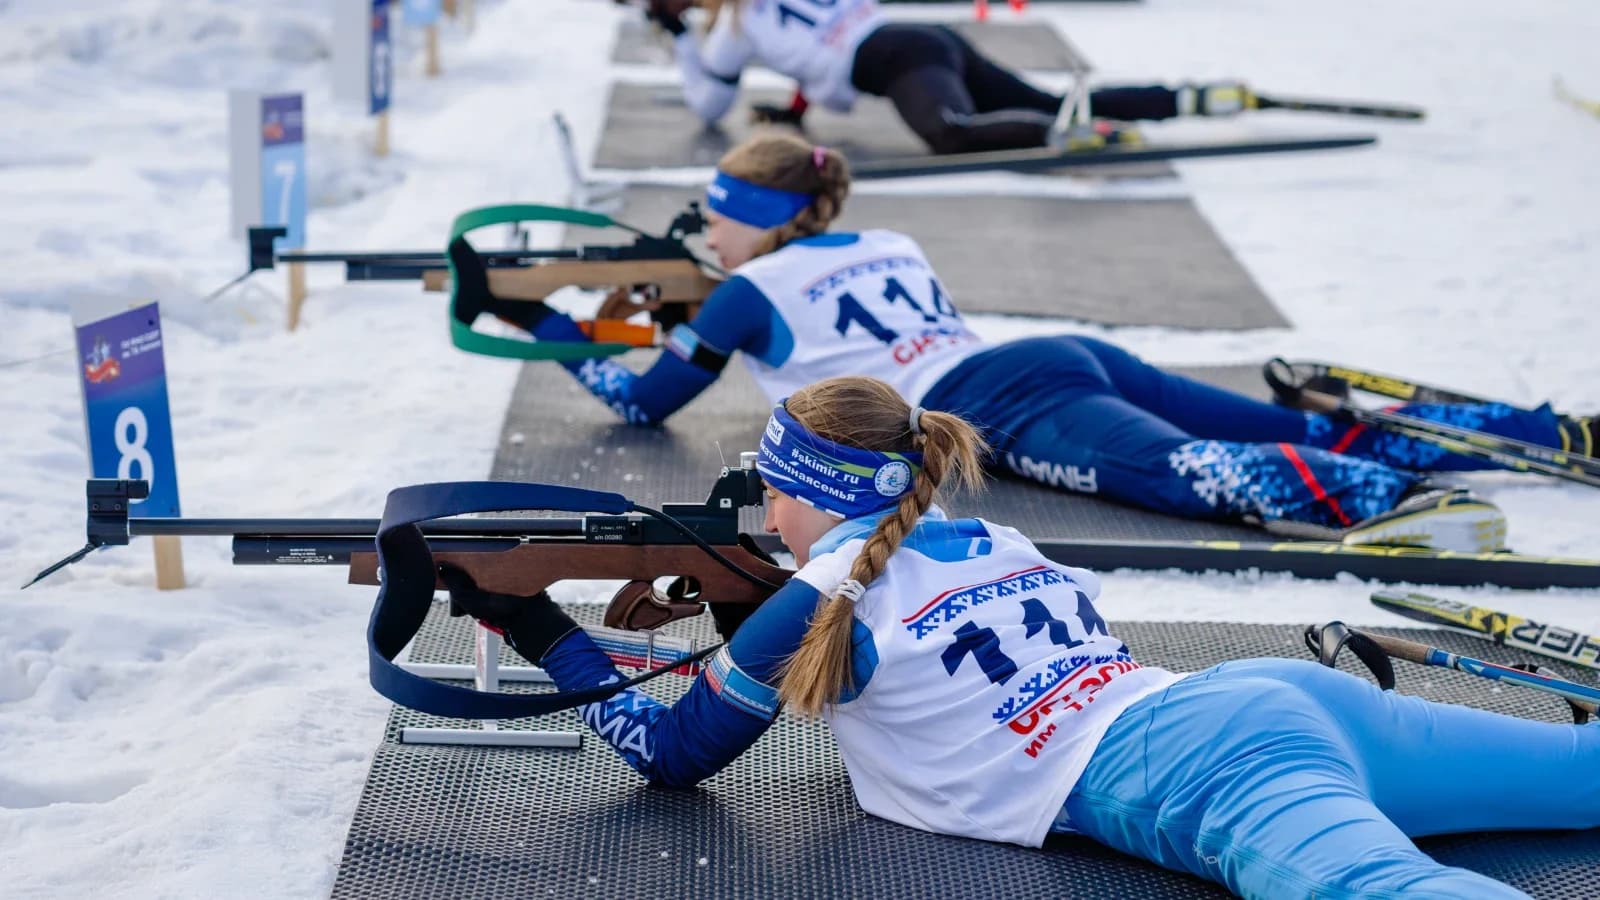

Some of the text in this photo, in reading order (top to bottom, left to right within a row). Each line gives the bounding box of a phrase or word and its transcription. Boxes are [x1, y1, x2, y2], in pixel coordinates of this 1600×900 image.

[273, 160, 297, 227] 7
[114, 406, 154, 504] 8
[791, 447, 860, 485] #skimir_ru
